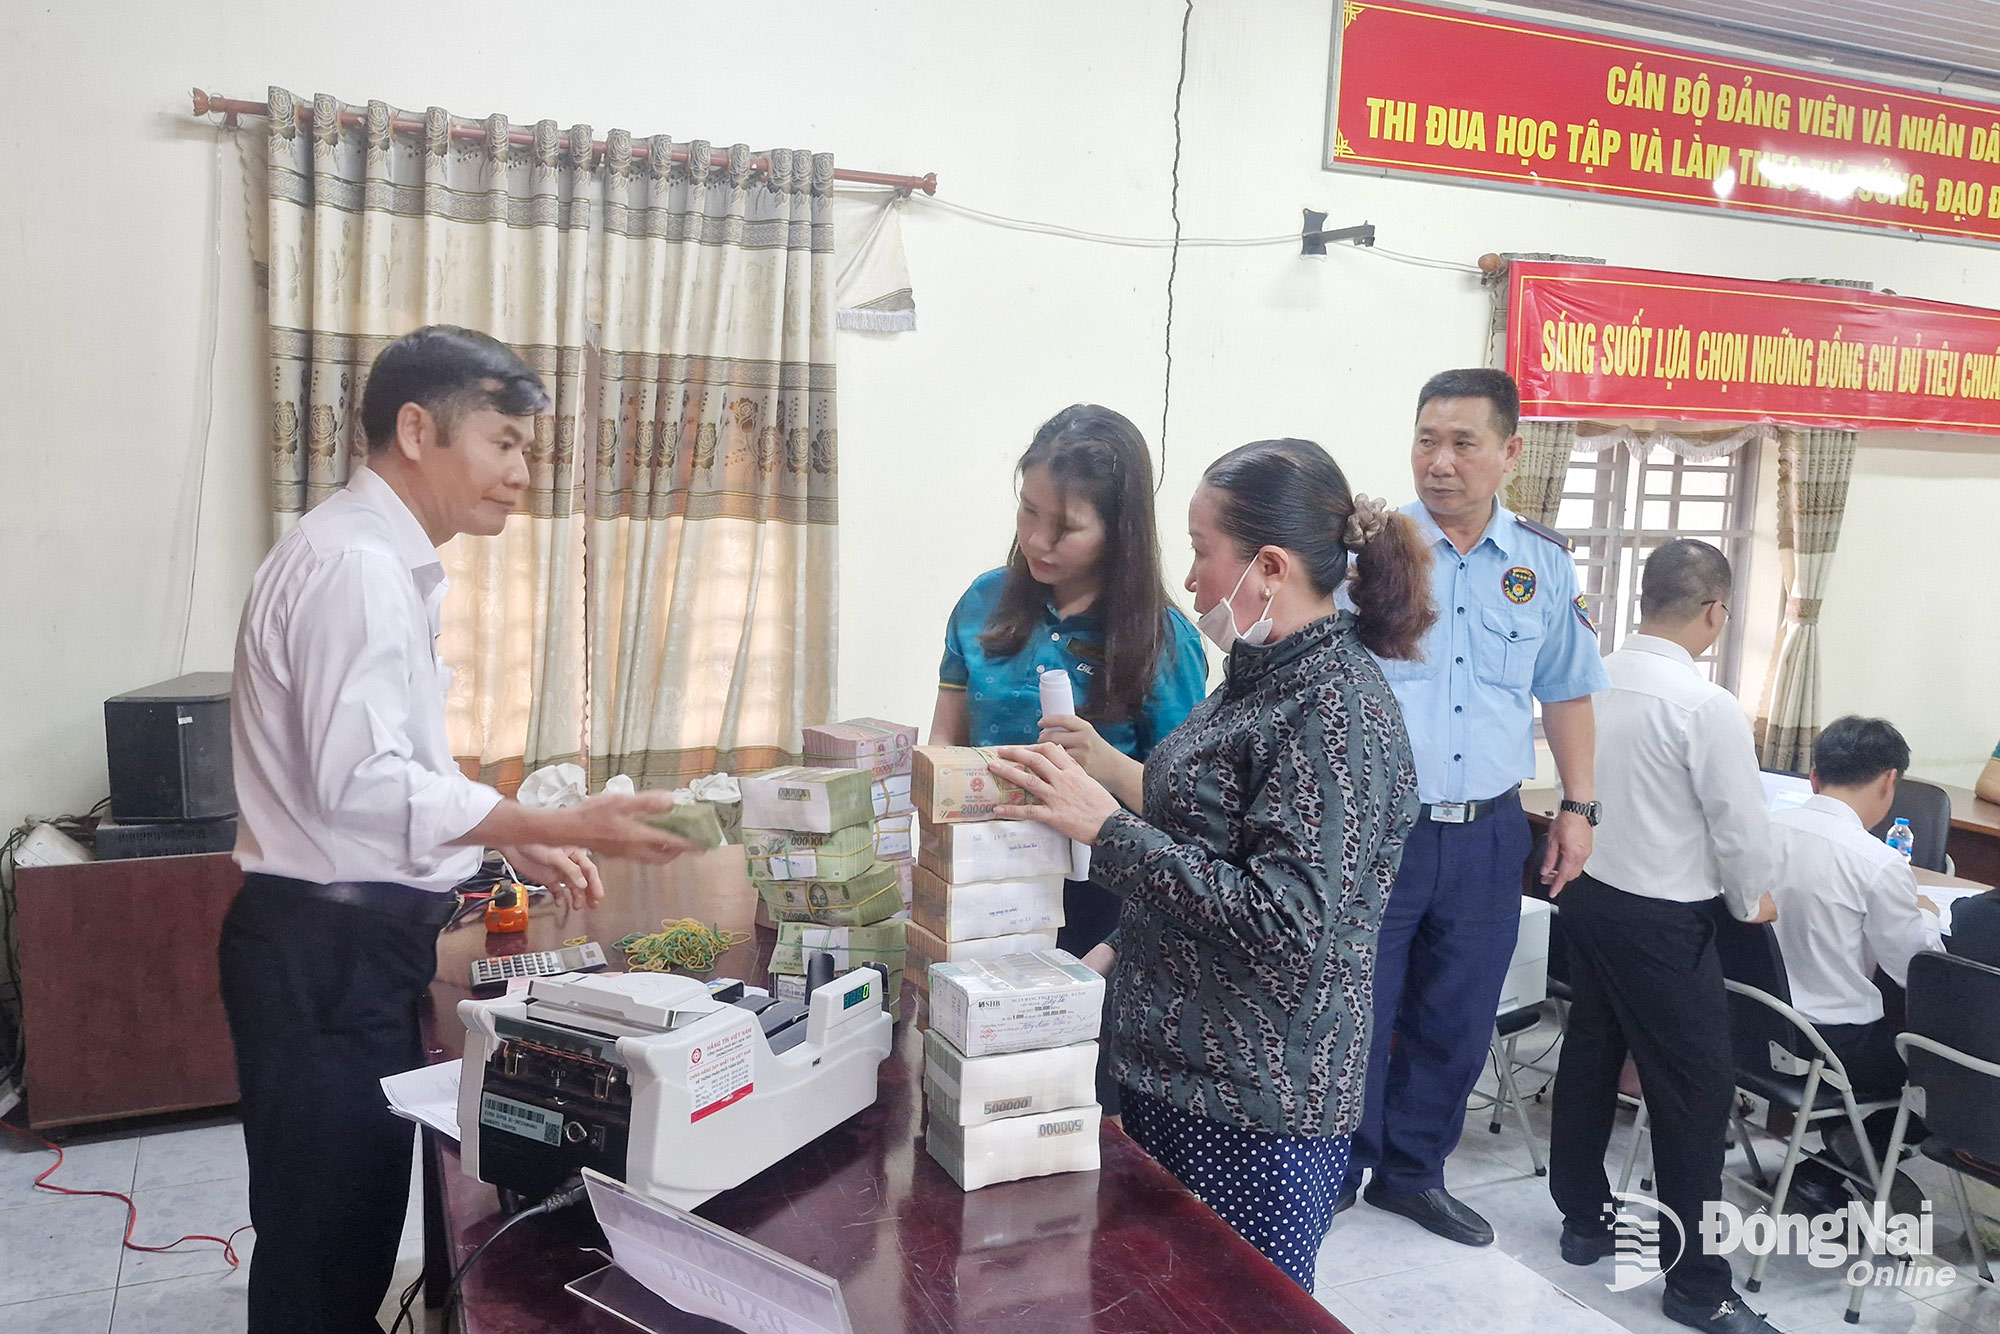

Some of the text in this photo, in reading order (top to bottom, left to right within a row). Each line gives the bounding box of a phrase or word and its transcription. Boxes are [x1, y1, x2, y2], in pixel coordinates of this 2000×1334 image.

[1606, 62, 1667, 112] CÁN
[1672, 72, 1711, 126] BỘ
[1716, 75, 1791, 131] ĐẢNG
[1799, 94, 1855, 141] VIÊN
[1862, 103, 1892, 147] VÀ
[1898, 113, 1965, 158] NHÂN
[1366, 97, 1417, 143] THI
[1425, 104, 1486, 152] ĐUA
[1495, 114, 1558, 166] HỌC
[1567, 118, 1621, 174] TẬP
[1630, 127, 1664, 174] VÀ
[1671, 133, 1731, 181] LÀM
[1935, 177, 1982, 222] ĐẠO
[1541, 309, 1597, 375] SÁNG
[1600, 308, 1653, 377] SUỐT
[1654, 324, 1691, 390] LỰA
[1695, 330, 1749, 393] CHỌN
[1750, 327, 1814, 387] NHỮNG
[1815, 324, 1865, 390] ĐỒNG
[1867, 336, 1898, 392] CHÍ
[1897, 332, 1923, 394] ĐỦ
[1924, 340, 1960, 397] TIÊU
[984, 1099, 1028, 1115] 500000
